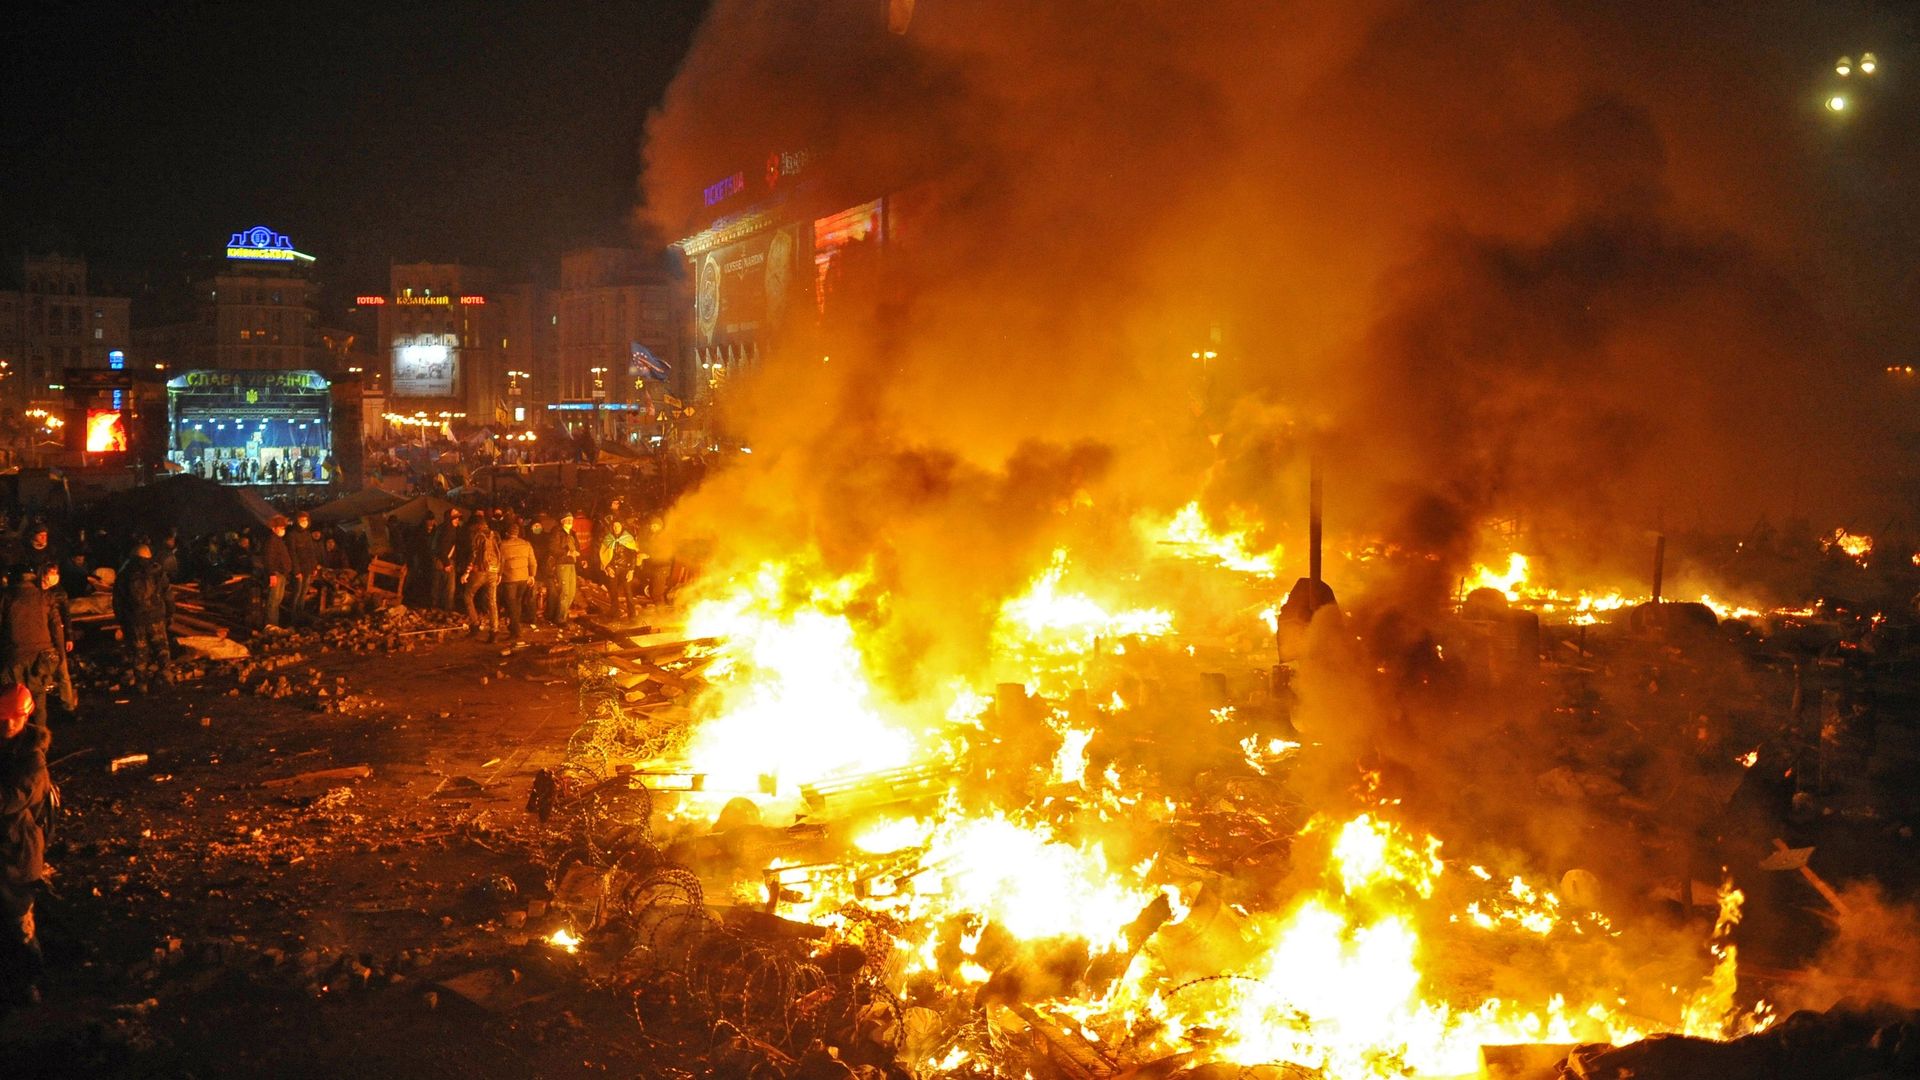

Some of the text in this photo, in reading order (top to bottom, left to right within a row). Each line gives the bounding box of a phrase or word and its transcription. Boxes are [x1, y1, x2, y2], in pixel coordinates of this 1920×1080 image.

[356, 295, 449, 306] ГОТЕЛЬ КОЗАЦЬКИЙ
[460, 296, 486, 305] HOTEL
[187, 372, 241, 386] СЛАВА
